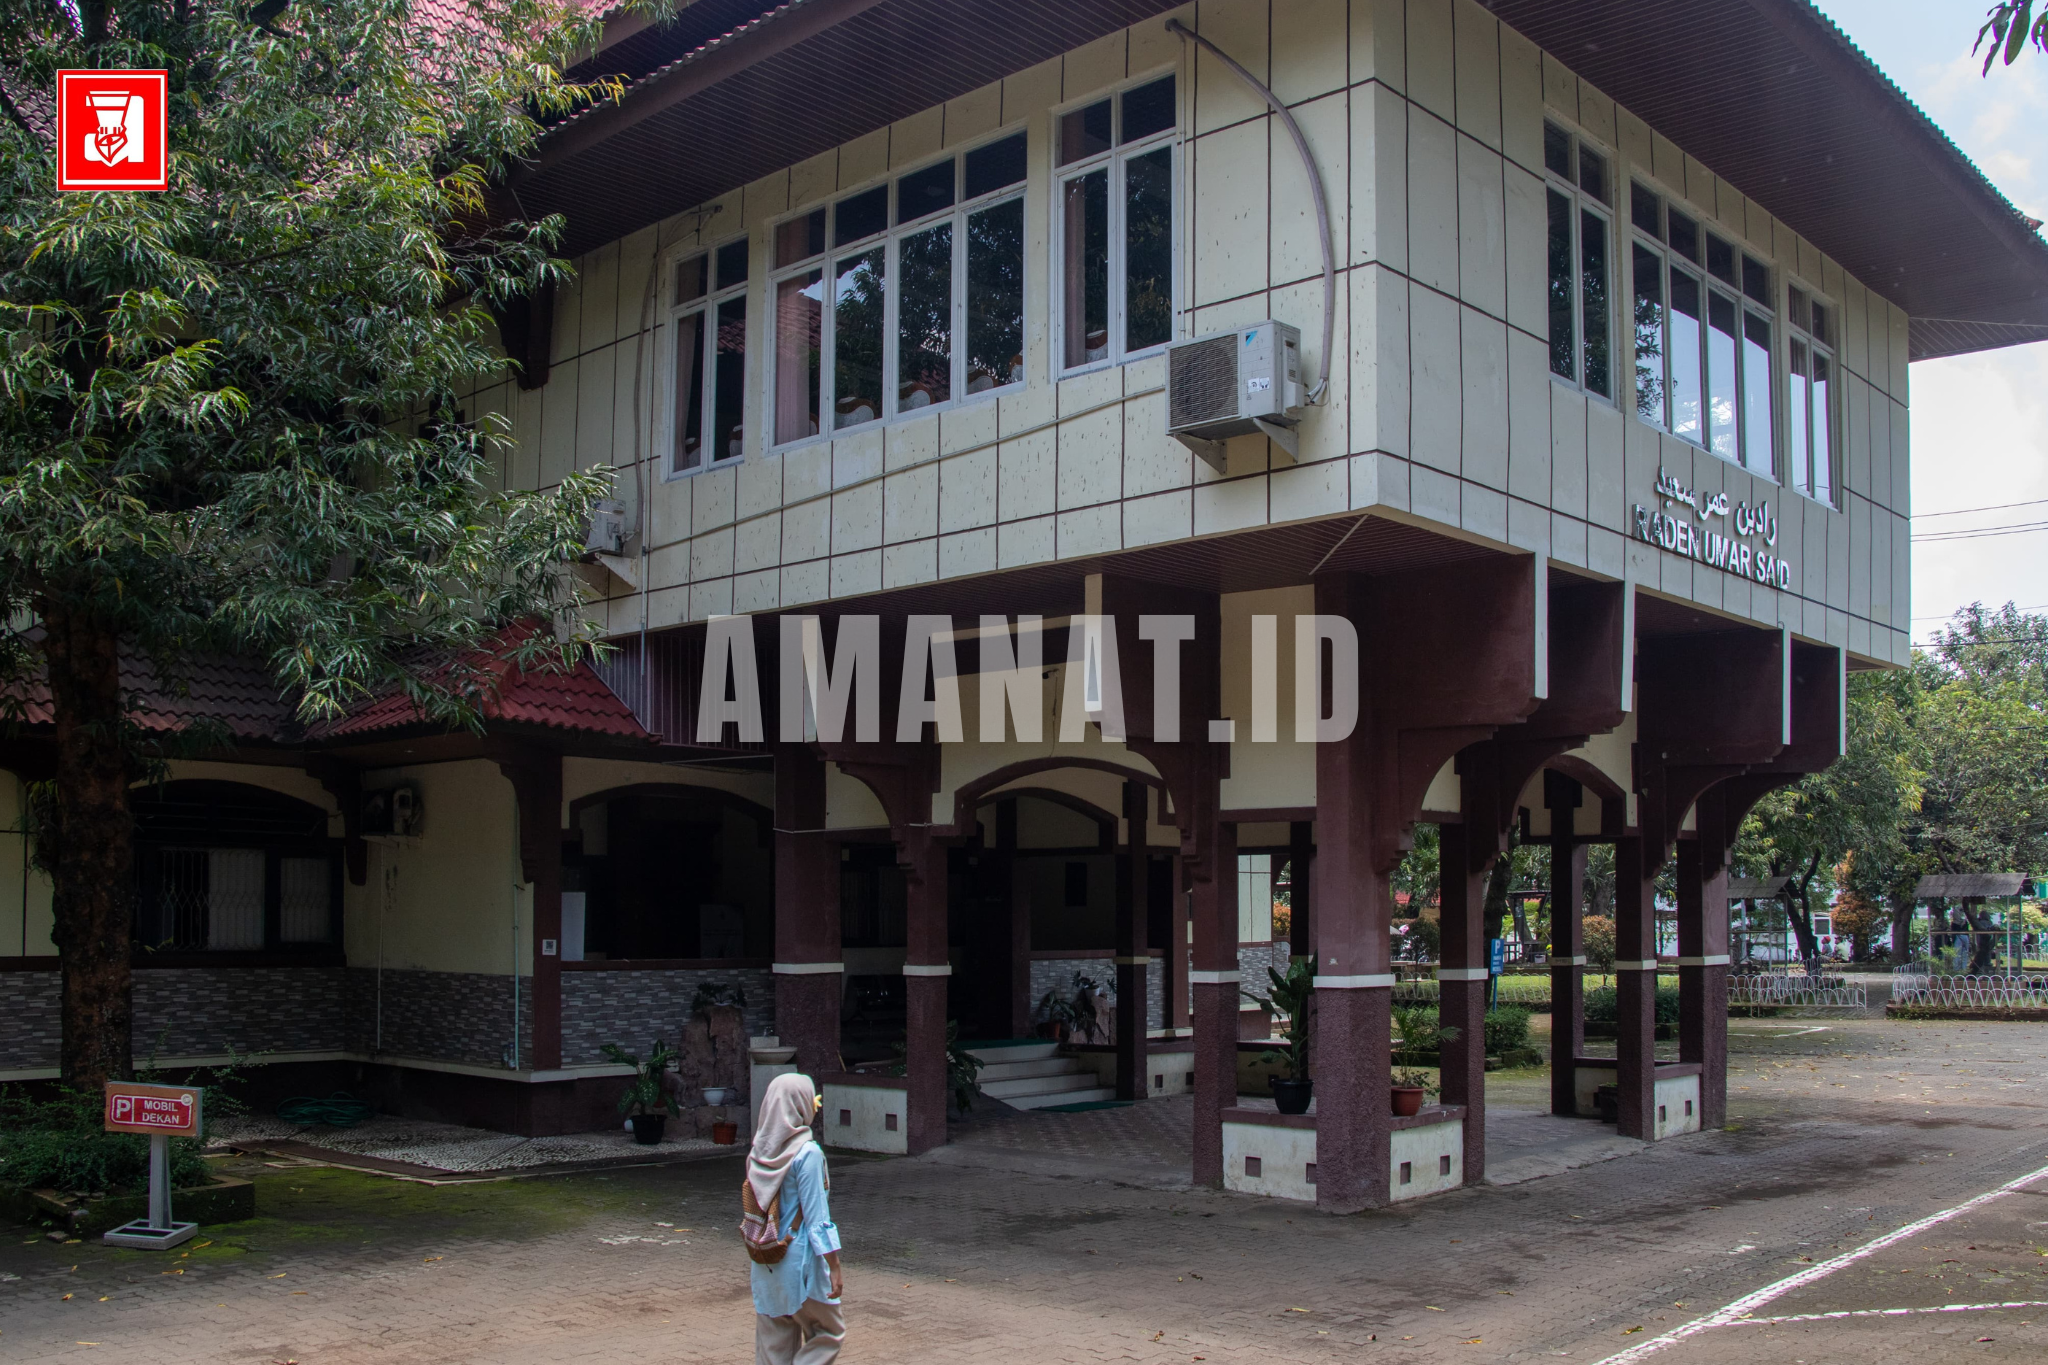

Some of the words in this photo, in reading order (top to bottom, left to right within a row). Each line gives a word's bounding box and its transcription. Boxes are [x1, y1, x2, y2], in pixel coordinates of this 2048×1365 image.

[1653, 465, 1696, 508] سعيد
[1695, 491, 1729, 520] عمر
[1733, 501, 1775, 546] رادين
[1632, 504, 1699, 558] RADEN
[1702, 530, 1750, 577] UMAR
[1754, 551, 1790, 589] SAID
[116, 1099, 131, 1118] P
[142, 1112, 179, 1124] DEKAN
[144, 1100, 178, 1112] MOBIL
